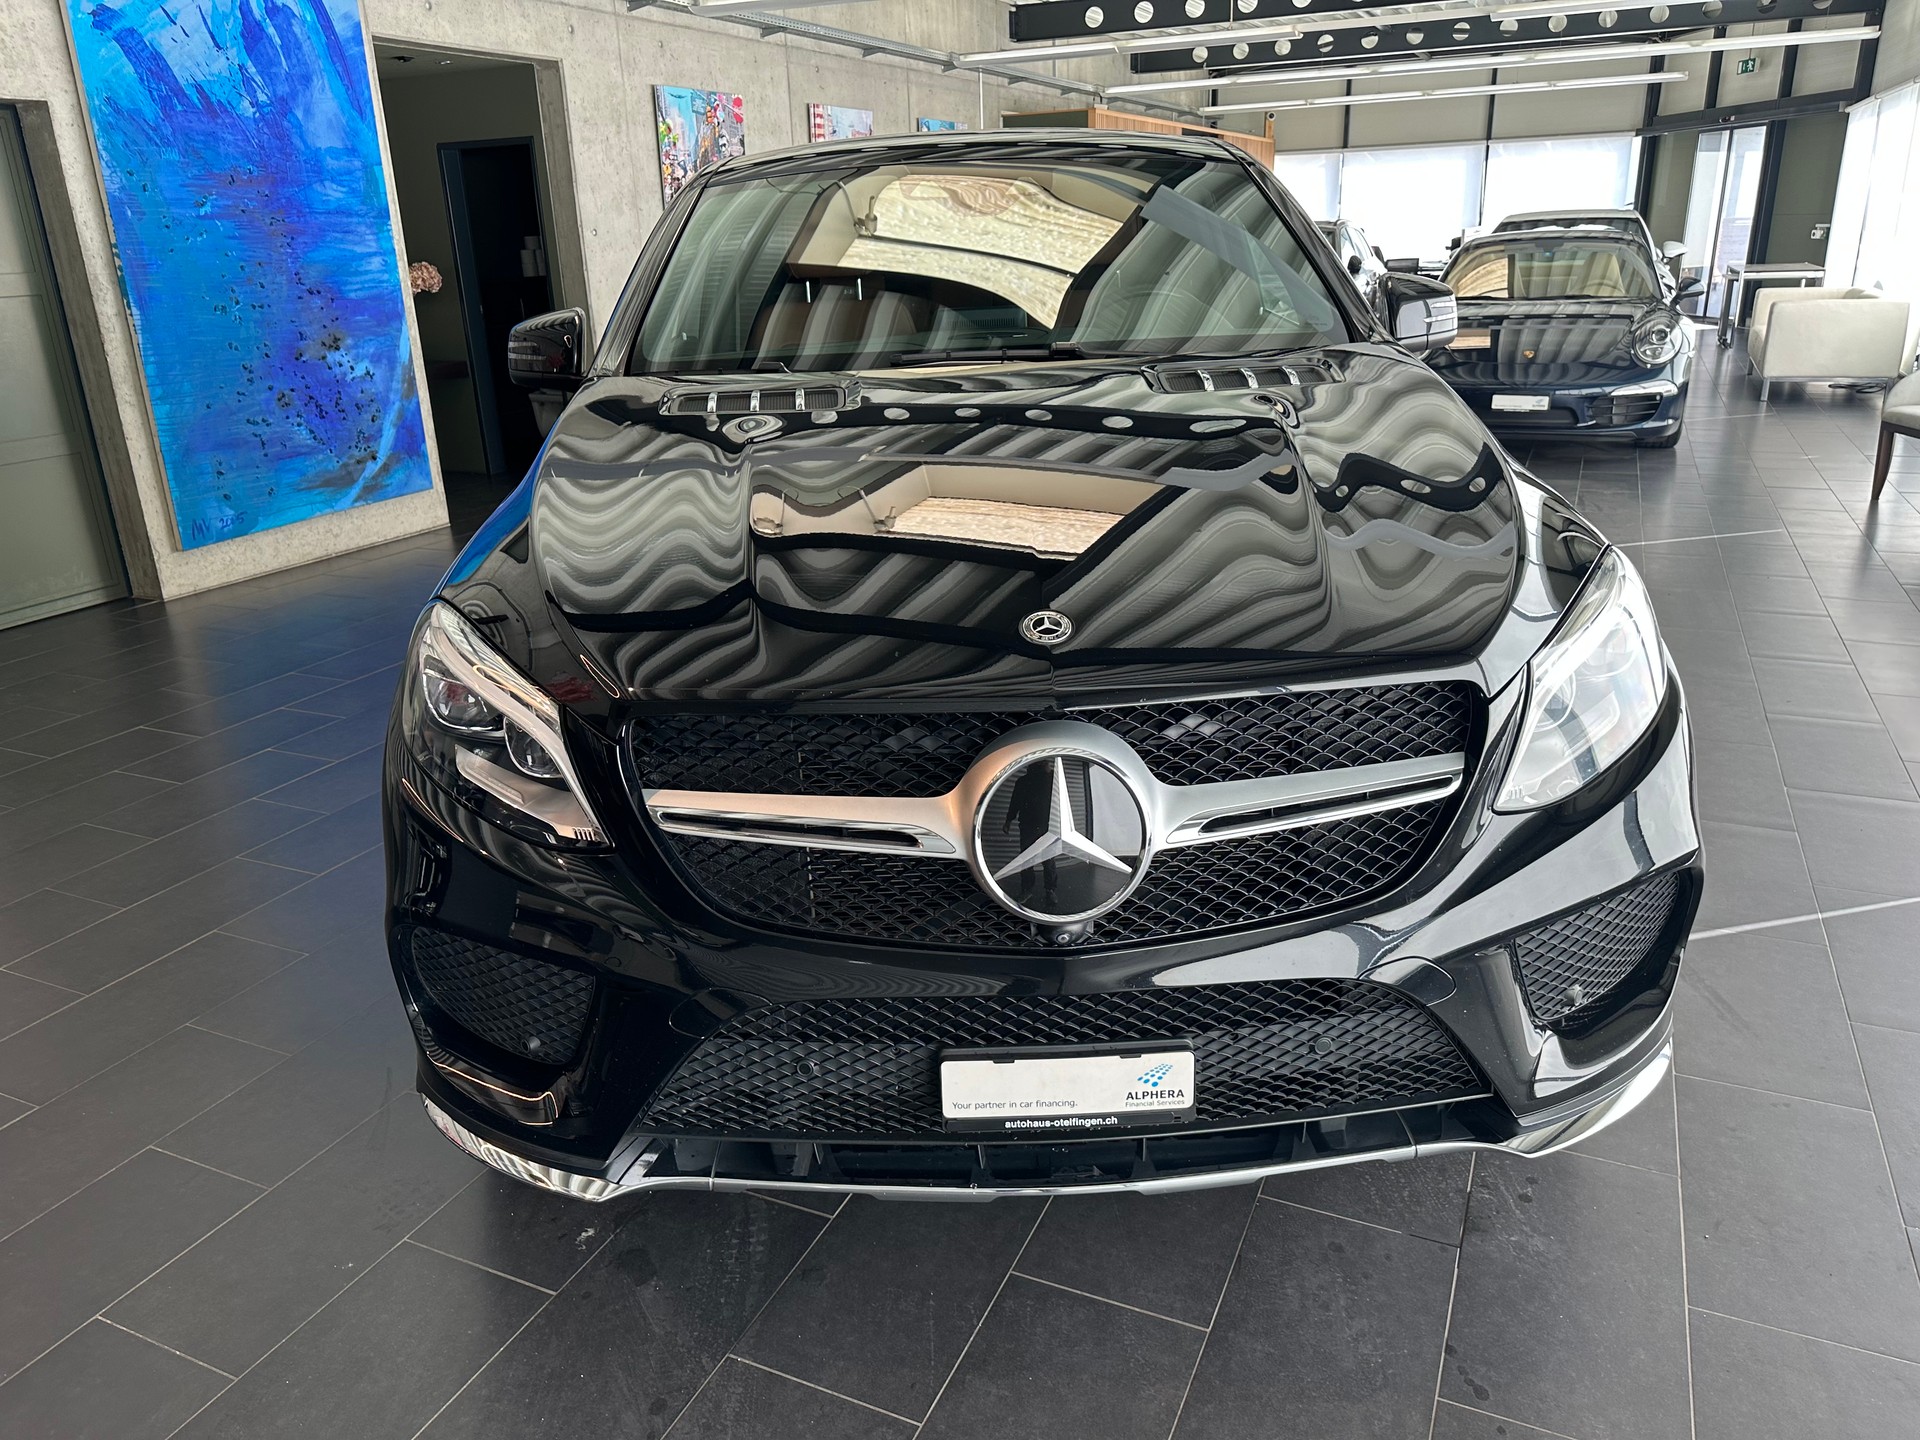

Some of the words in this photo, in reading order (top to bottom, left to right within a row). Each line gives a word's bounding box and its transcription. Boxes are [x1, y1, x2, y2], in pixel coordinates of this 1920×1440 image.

[1126, 1089, 1185, 1101] ALPHERA
[952, 1101, 972, 1110] Your
[974, 1100, 1006, 1110] partner
[1008, 1100, 1017, 1109] in
[1019, 1100, 1033, 1108] car
[1035, 1098, 1078, 1108] financing.
[1004, 1115, 1118, 1129] autohaus-otelfingen.ch
